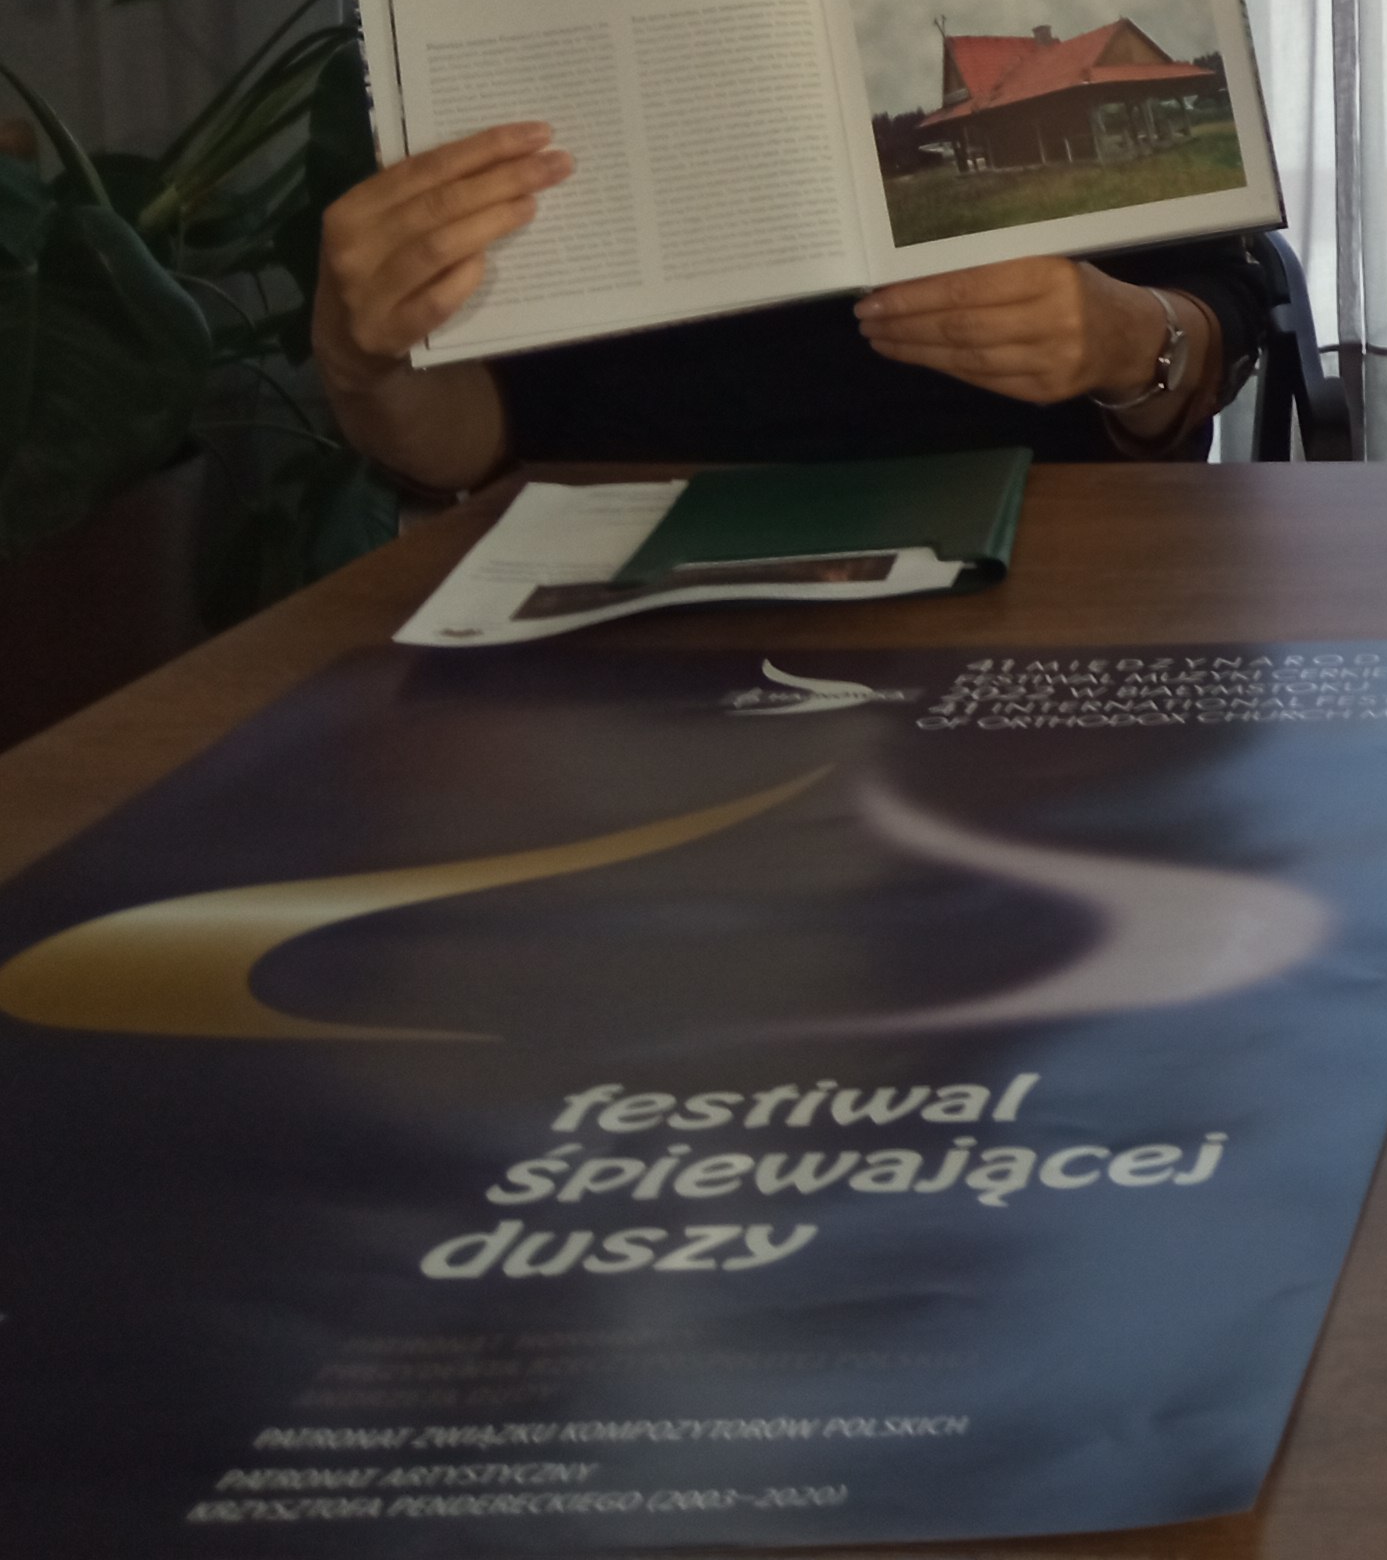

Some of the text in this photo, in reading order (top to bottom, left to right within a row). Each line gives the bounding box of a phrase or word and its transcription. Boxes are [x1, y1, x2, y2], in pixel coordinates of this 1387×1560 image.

[550, 1072, 1042, 1134] festiwal
[485, 1131, 1229, 1207] śpiewającej
[419, 1219, 818, 1280] duszy
